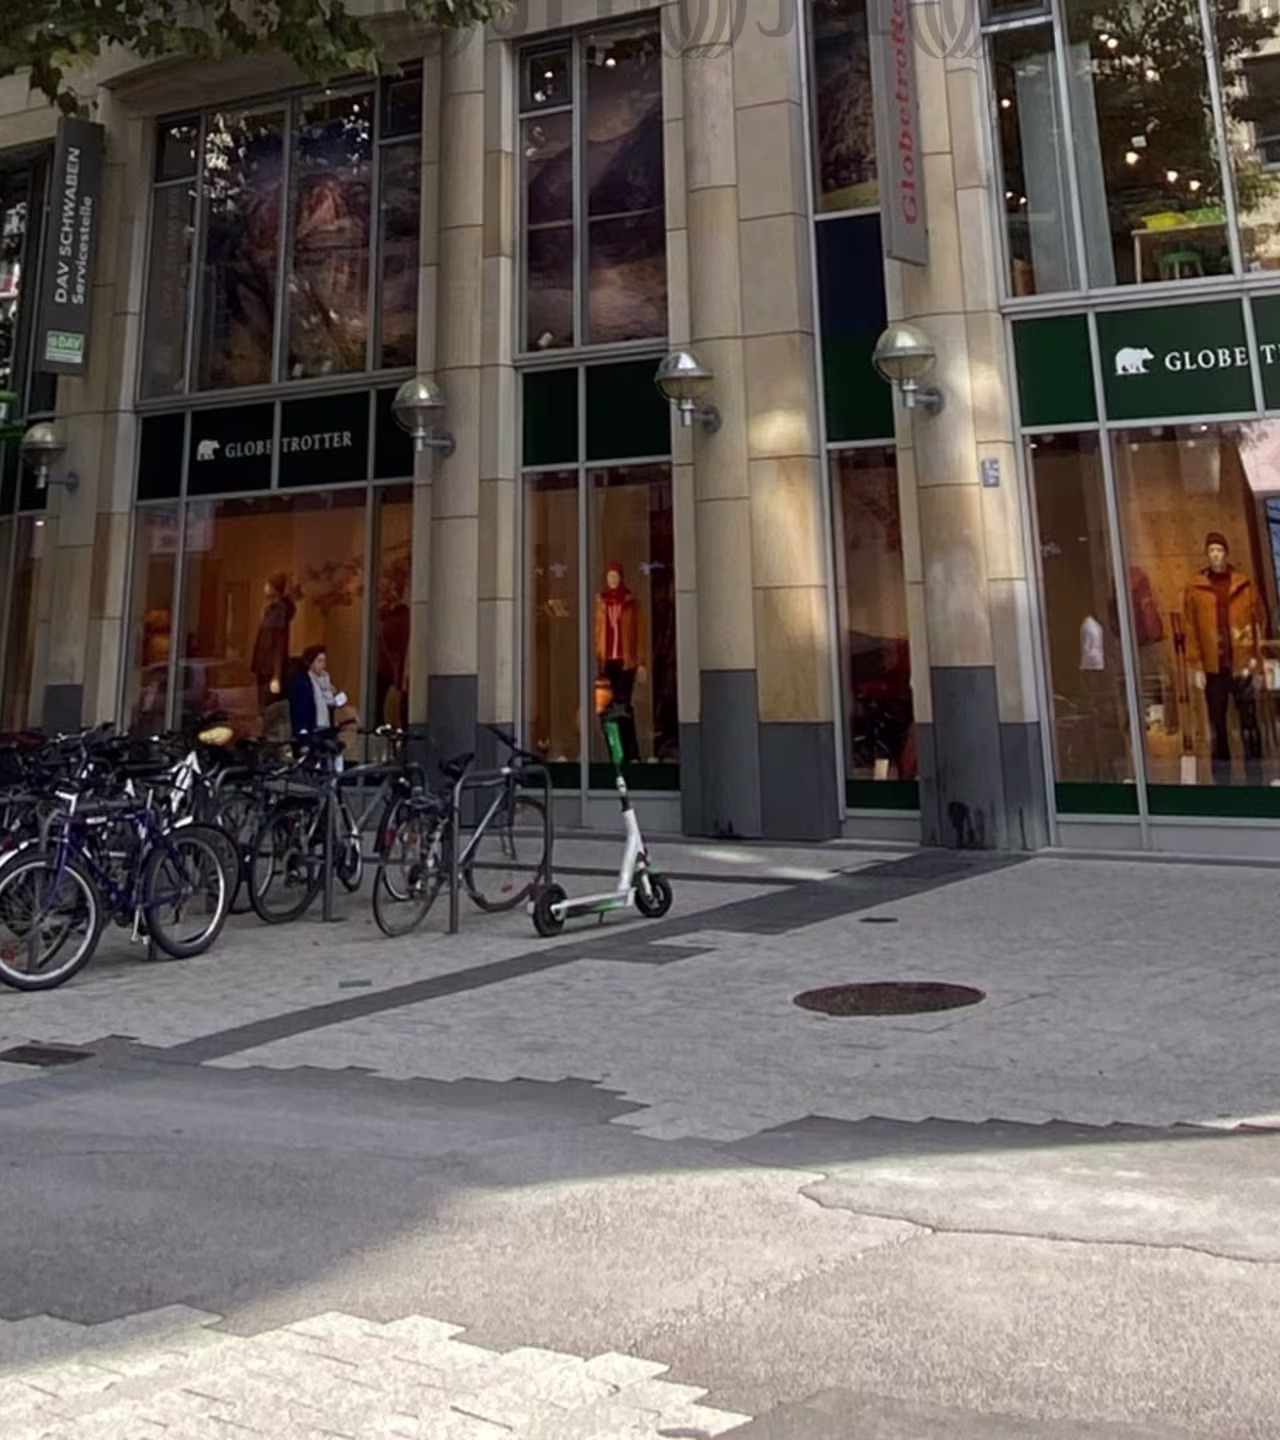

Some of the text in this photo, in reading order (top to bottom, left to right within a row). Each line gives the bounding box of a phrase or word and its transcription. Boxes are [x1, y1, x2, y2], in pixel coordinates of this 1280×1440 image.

[55, 146, 81, 304] DAV SCHWABEN
[72, 196, 93, 305] Servicestelle
